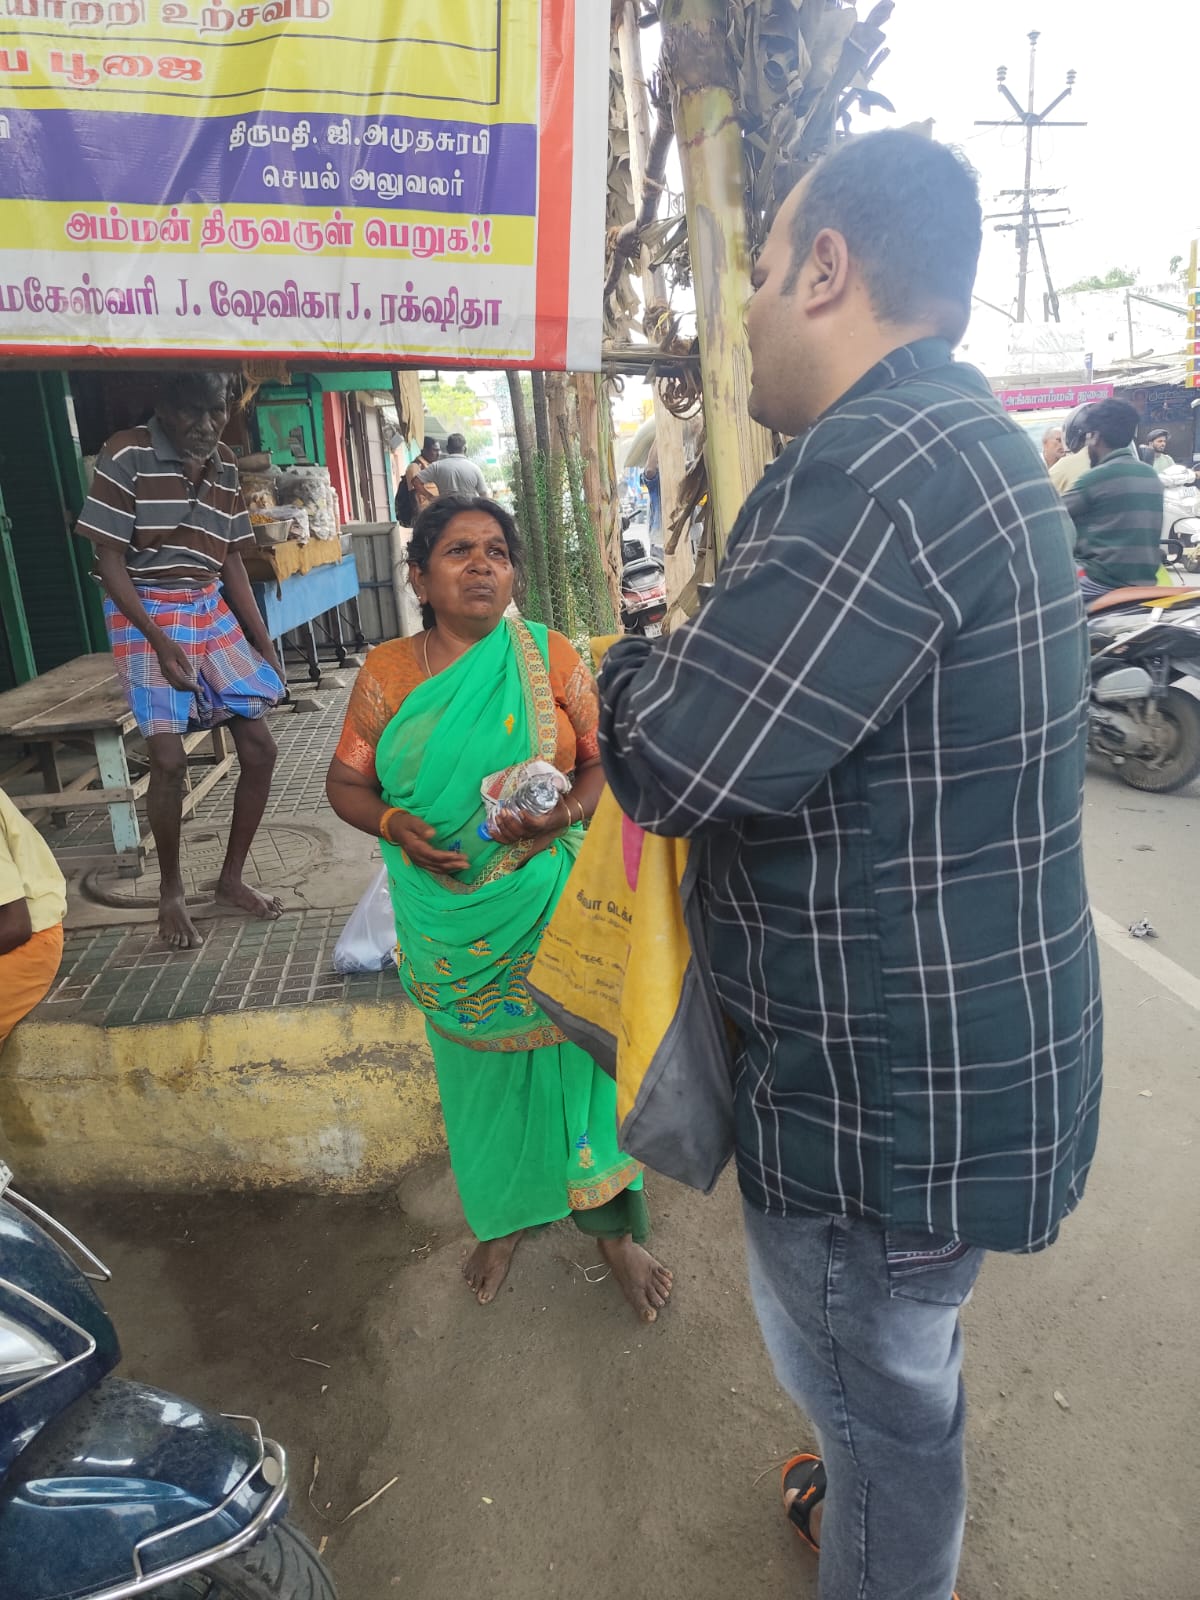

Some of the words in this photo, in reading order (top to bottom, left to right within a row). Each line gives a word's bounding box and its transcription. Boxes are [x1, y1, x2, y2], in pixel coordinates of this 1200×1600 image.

[51, 51, 203, 86] பூஜை
[229, 119, 318, 152] திருமதி.
[262, 162, 341, 190] செயல்
[350, 168, 465, 200] அலுவலர்
[66, 206, 191, 242] அம்மன்
[200, 208, 355, 251] திருவருள்
[366, 218, 492, 259] பெறுக!!
[175, 278, 202, 317] J.
[208, 279, 341, 326] ஷேவிகா
[346, 282, 372, 321] J.
[379, 280, 503, 334] ரக்ஷிதா
